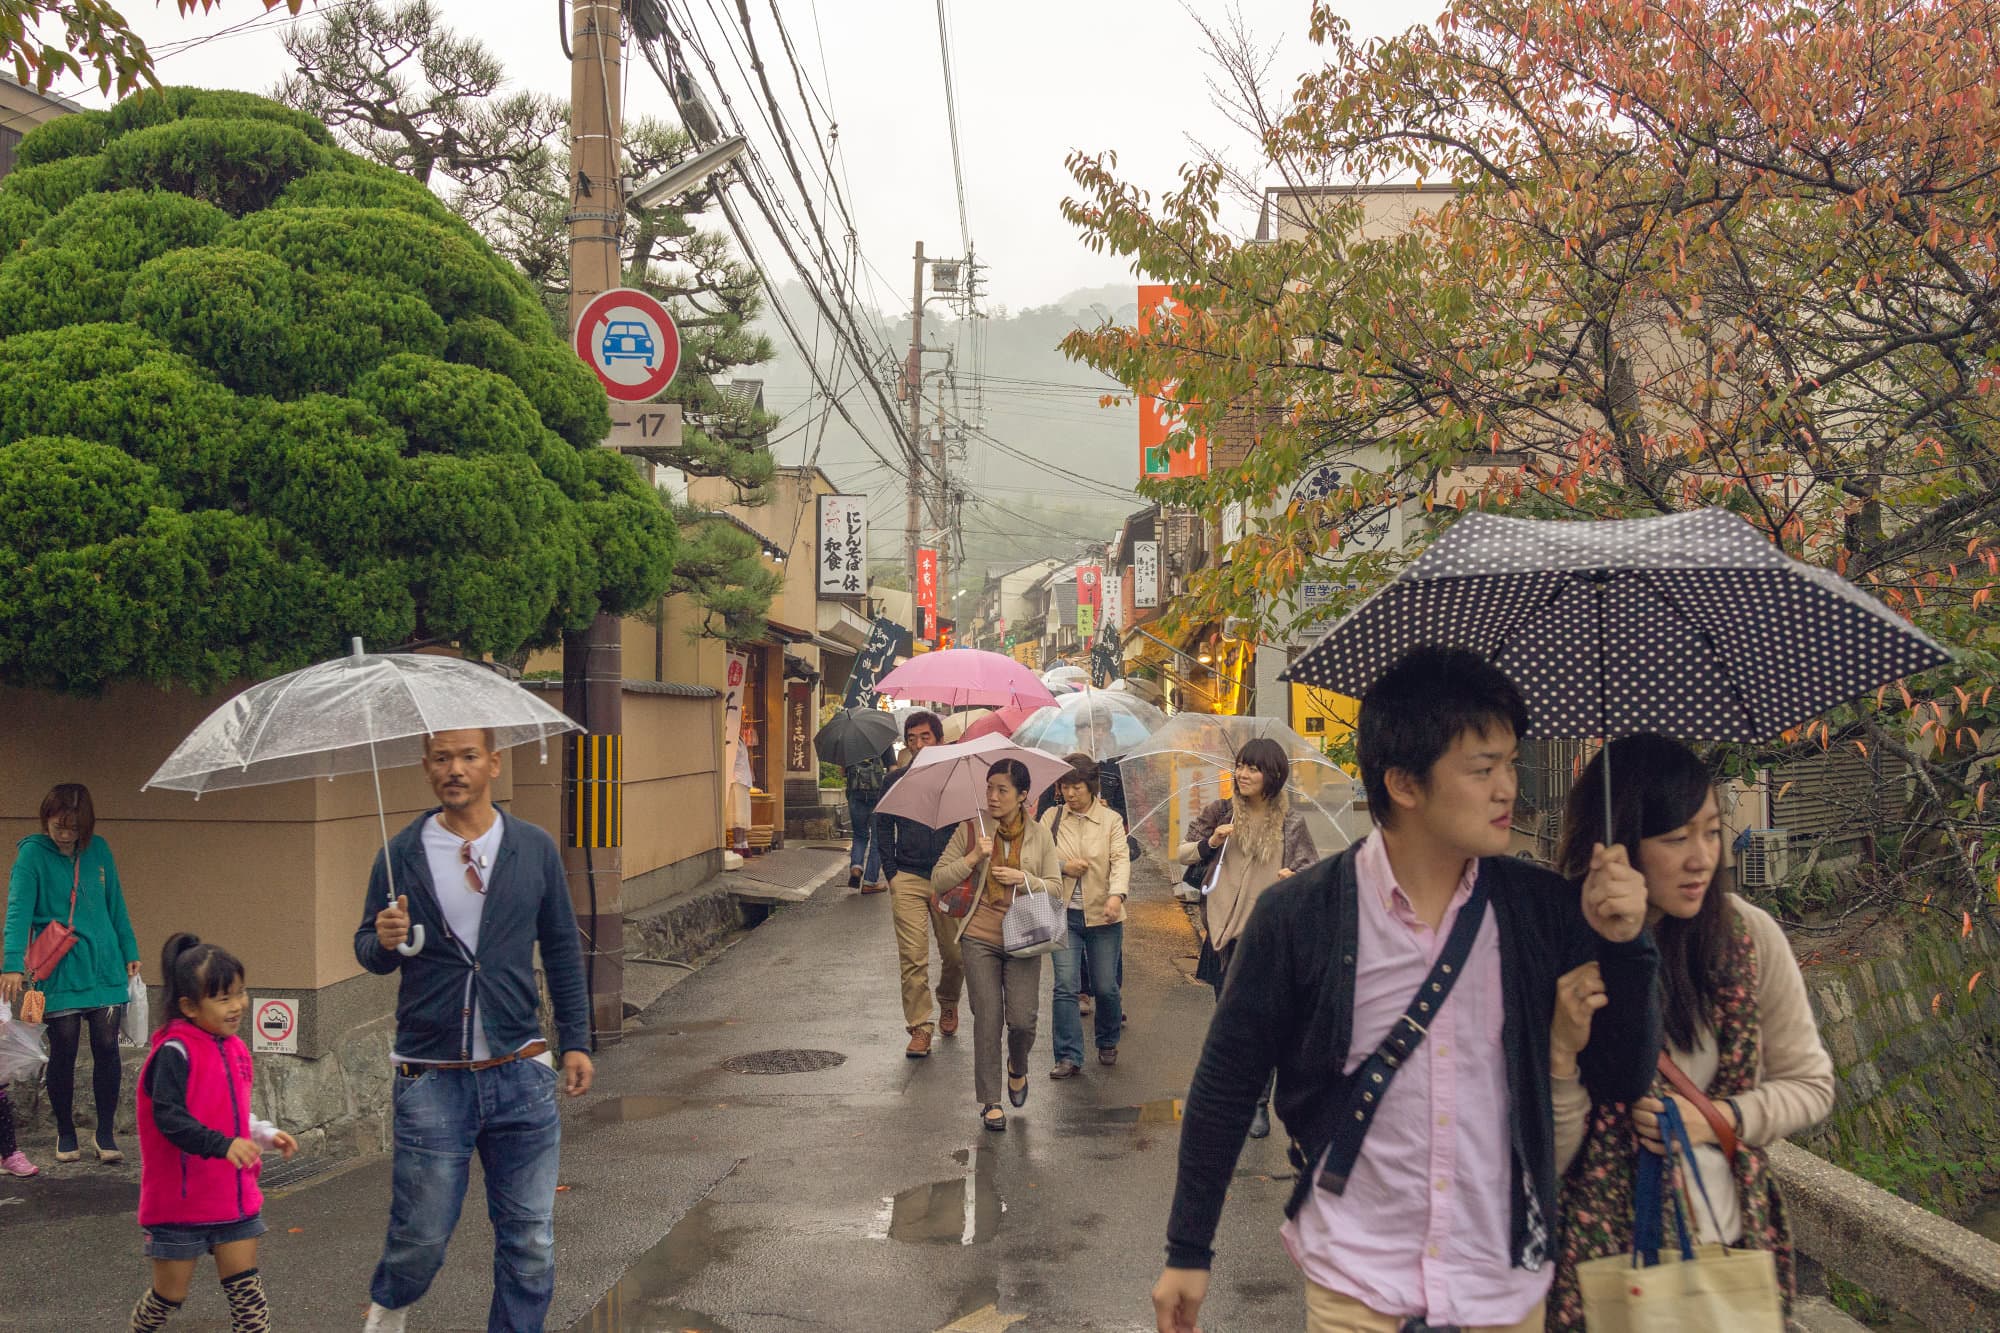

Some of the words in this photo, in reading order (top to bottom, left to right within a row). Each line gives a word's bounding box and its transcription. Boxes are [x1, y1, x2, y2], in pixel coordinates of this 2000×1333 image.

[824, 537, 842, 571] 和食
[845, 511, 863, 571] にしんそば
